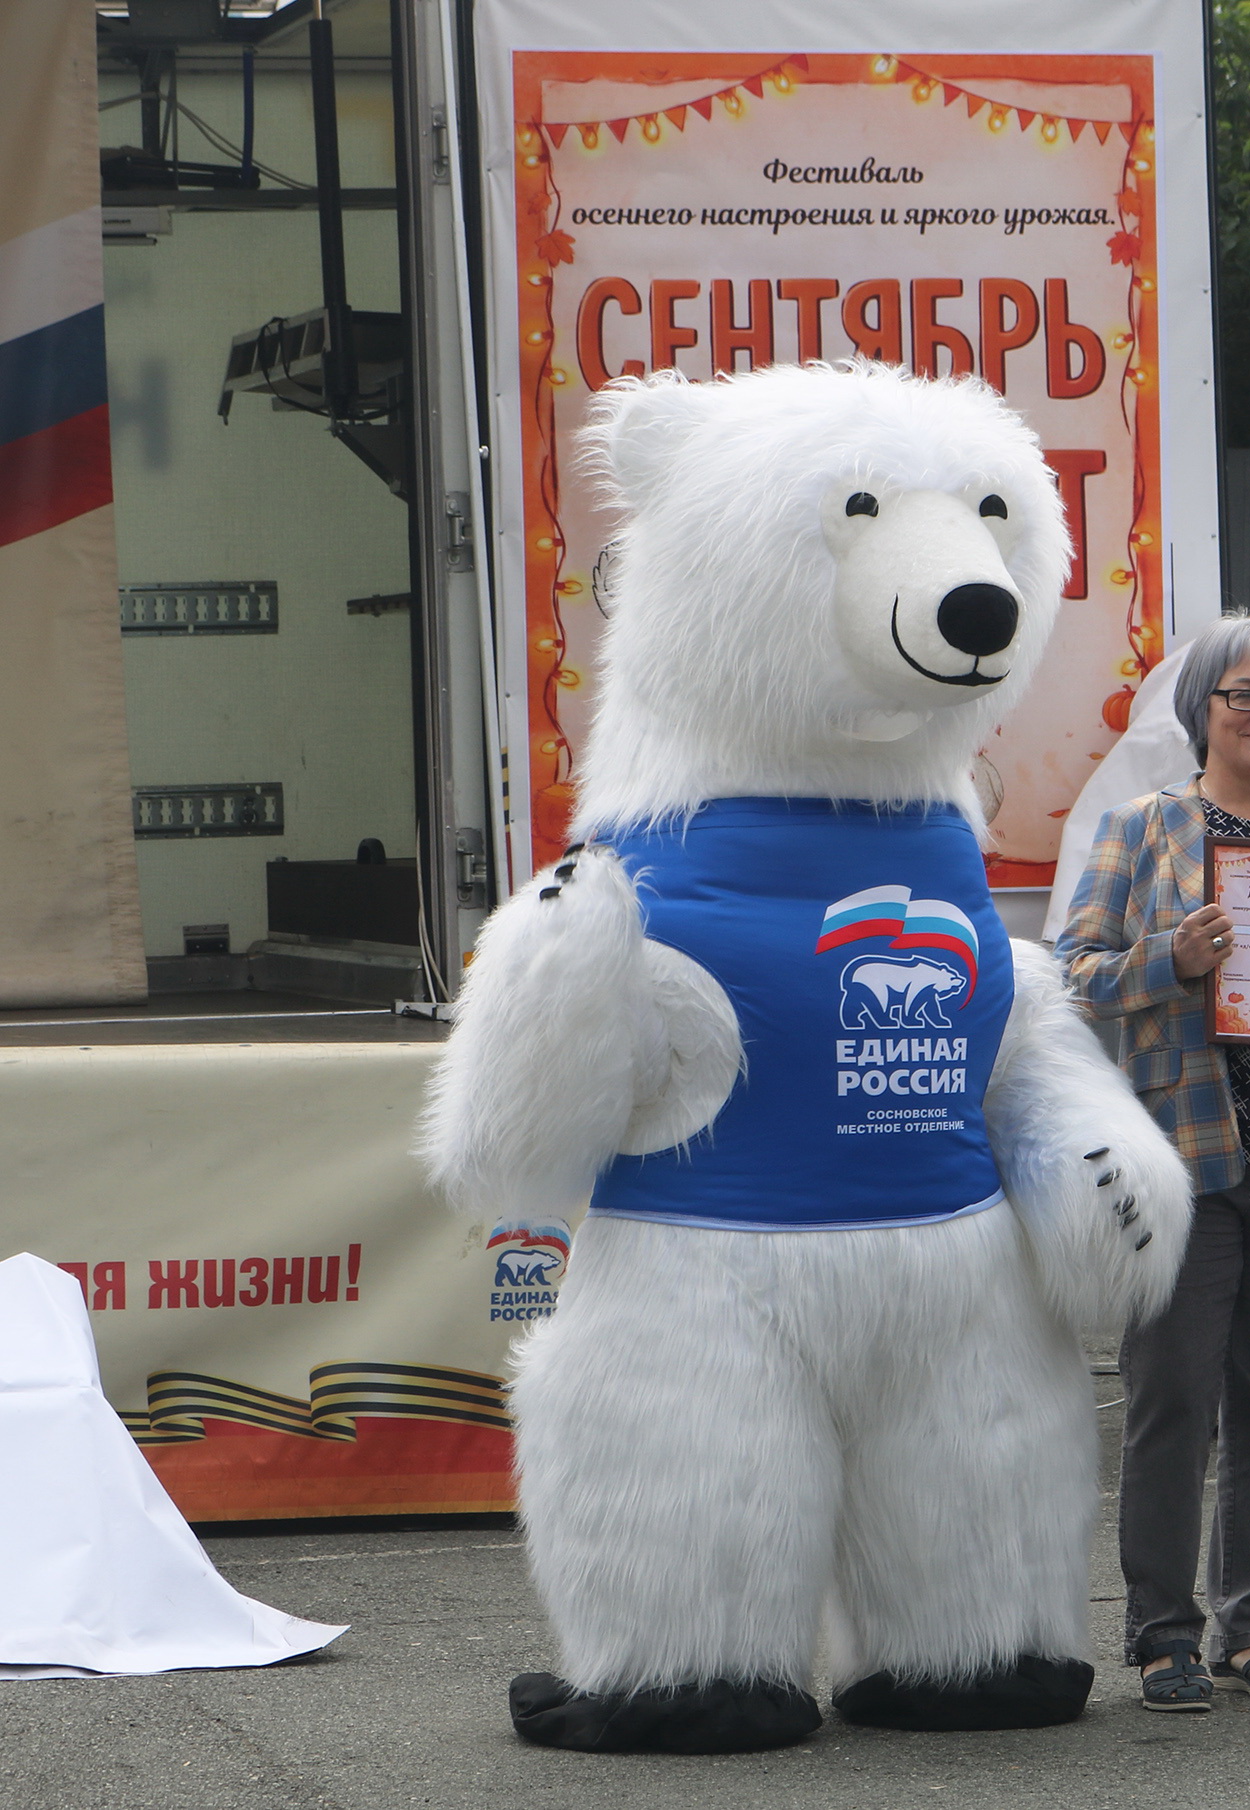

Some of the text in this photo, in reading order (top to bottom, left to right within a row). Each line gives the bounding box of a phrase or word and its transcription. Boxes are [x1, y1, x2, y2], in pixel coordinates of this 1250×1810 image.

[763, 156, 924, 188] Фестиваль
[571, 203, 1117, 236] осеннего настроения и яркого урожая.
[576, 277, 1107, 400] СЕНТЯБРЬ
[836, 1038, 968, 1066] ЕДИНАЯ
[837, 1068, 967, 1097] РОССИЯ
[836, 1120, 965, 1134] МЕСТНОЕ ОТДЕЛЕНИЕ
[866, 1108, 948, 1120] СОСНОВСКОЕ
[148, 1243, 362, 1309] жизни!
[490, 1307, 557, 1322] РОССИ
